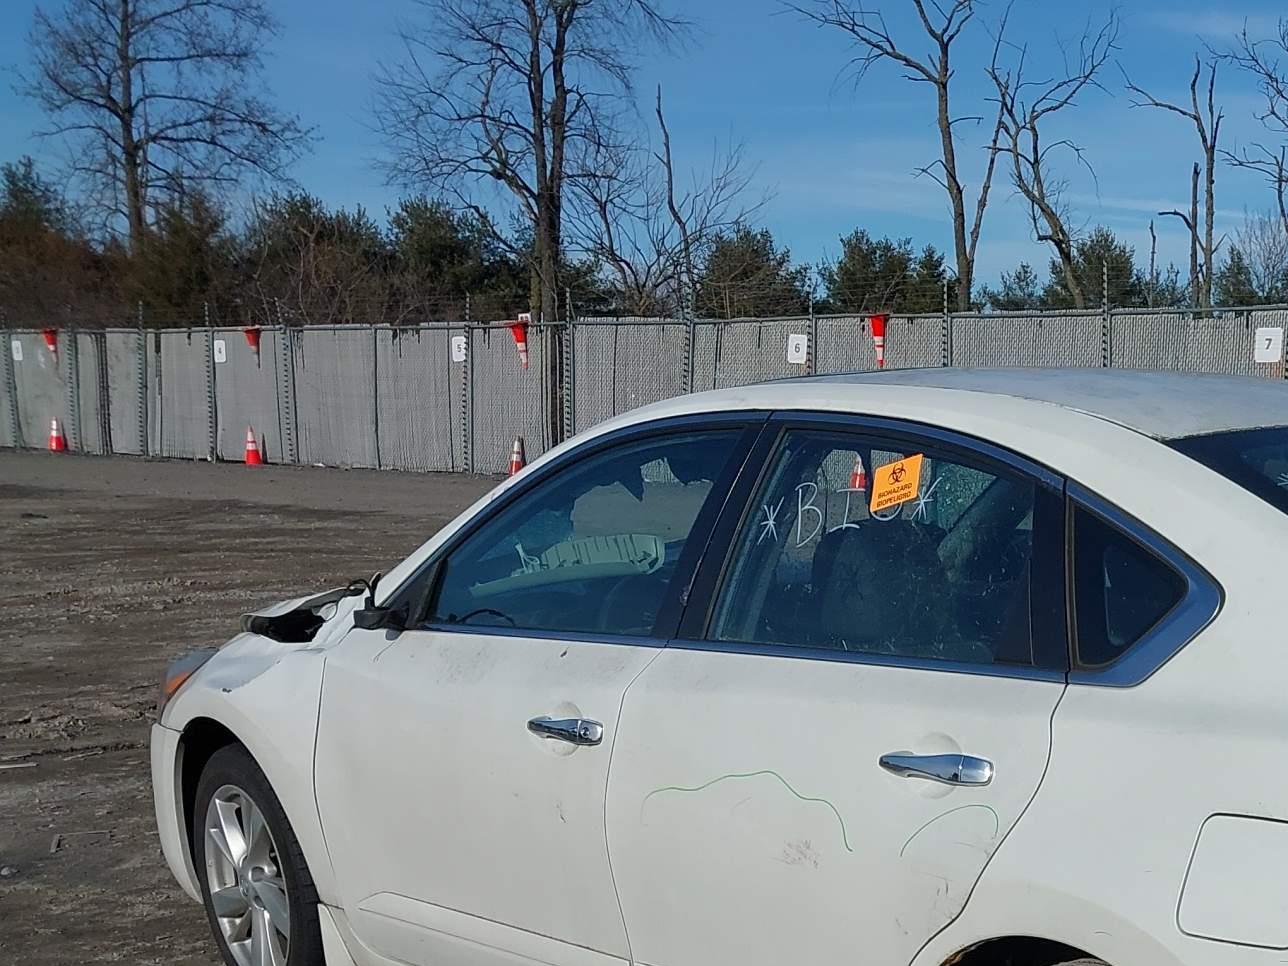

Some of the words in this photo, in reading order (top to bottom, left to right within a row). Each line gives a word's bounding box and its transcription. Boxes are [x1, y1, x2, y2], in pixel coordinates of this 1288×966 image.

[456, 343, 462, 353] 5
[794, 342, 801, 353] 6
[1264, 338, 1273, 351] 7
[877, 482, 913, 500] BIOHAZARD
